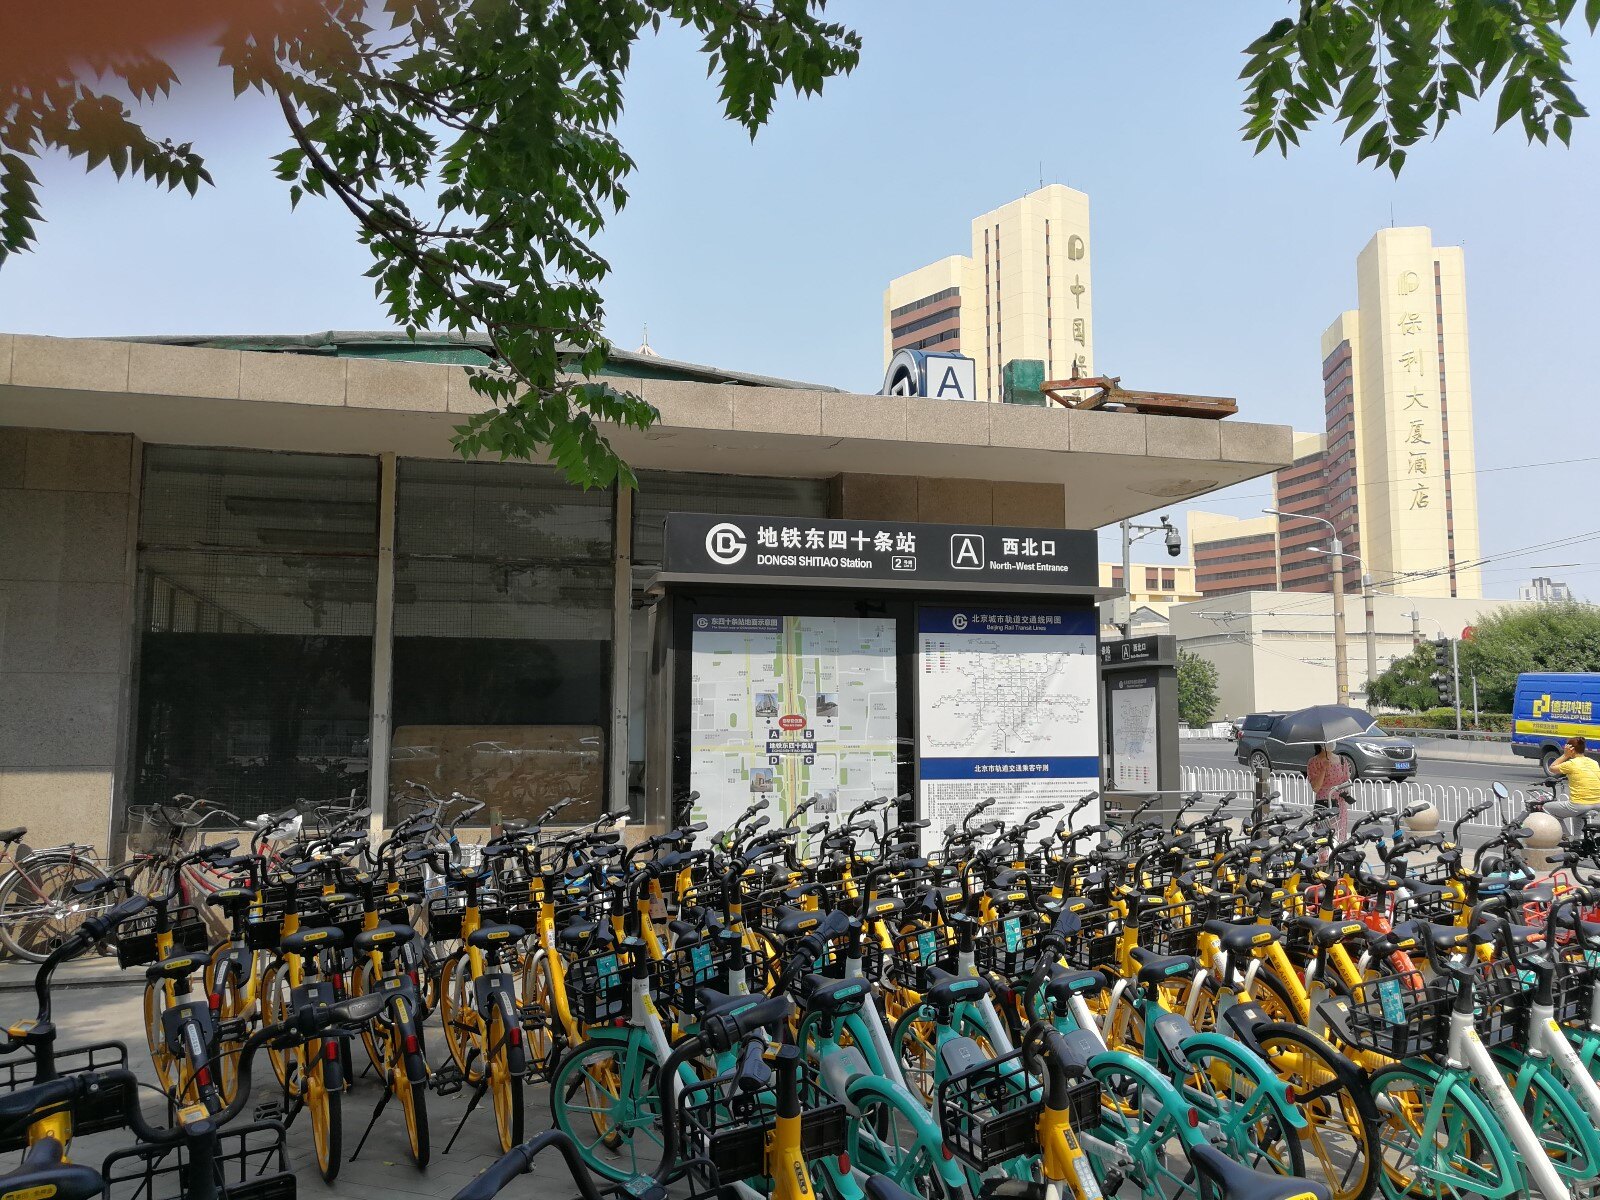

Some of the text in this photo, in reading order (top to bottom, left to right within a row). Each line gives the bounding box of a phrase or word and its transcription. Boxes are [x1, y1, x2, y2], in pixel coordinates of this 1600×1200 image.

[936, 365, 965, 399] A
[1396, 311, 1431, 510] 保利大厦酒店
[757, 526, 916, 553] 地铁东四十条站
[956, 537, 979, 565] A
[1001, 537, 1056, 557] 西北口
[757, 554, 873, 569] DONGSI SHITIAO Station
[989, 560, 1069, 572] North-West Entrance
[971, 614, 1062, 625] 北京城市轨道交通线网图
[986, 624, 1004, 632] Beijing
[1551, 700, 1592, 714] 德邦快递
[770, 730, 778, 738] A
[805, 730, 812, 738] B
[771, 756, 778, 764] D
[805, 756, 812, 764] C
[974, 763, 1050, 773] 北京市轨道交通乘客守则
